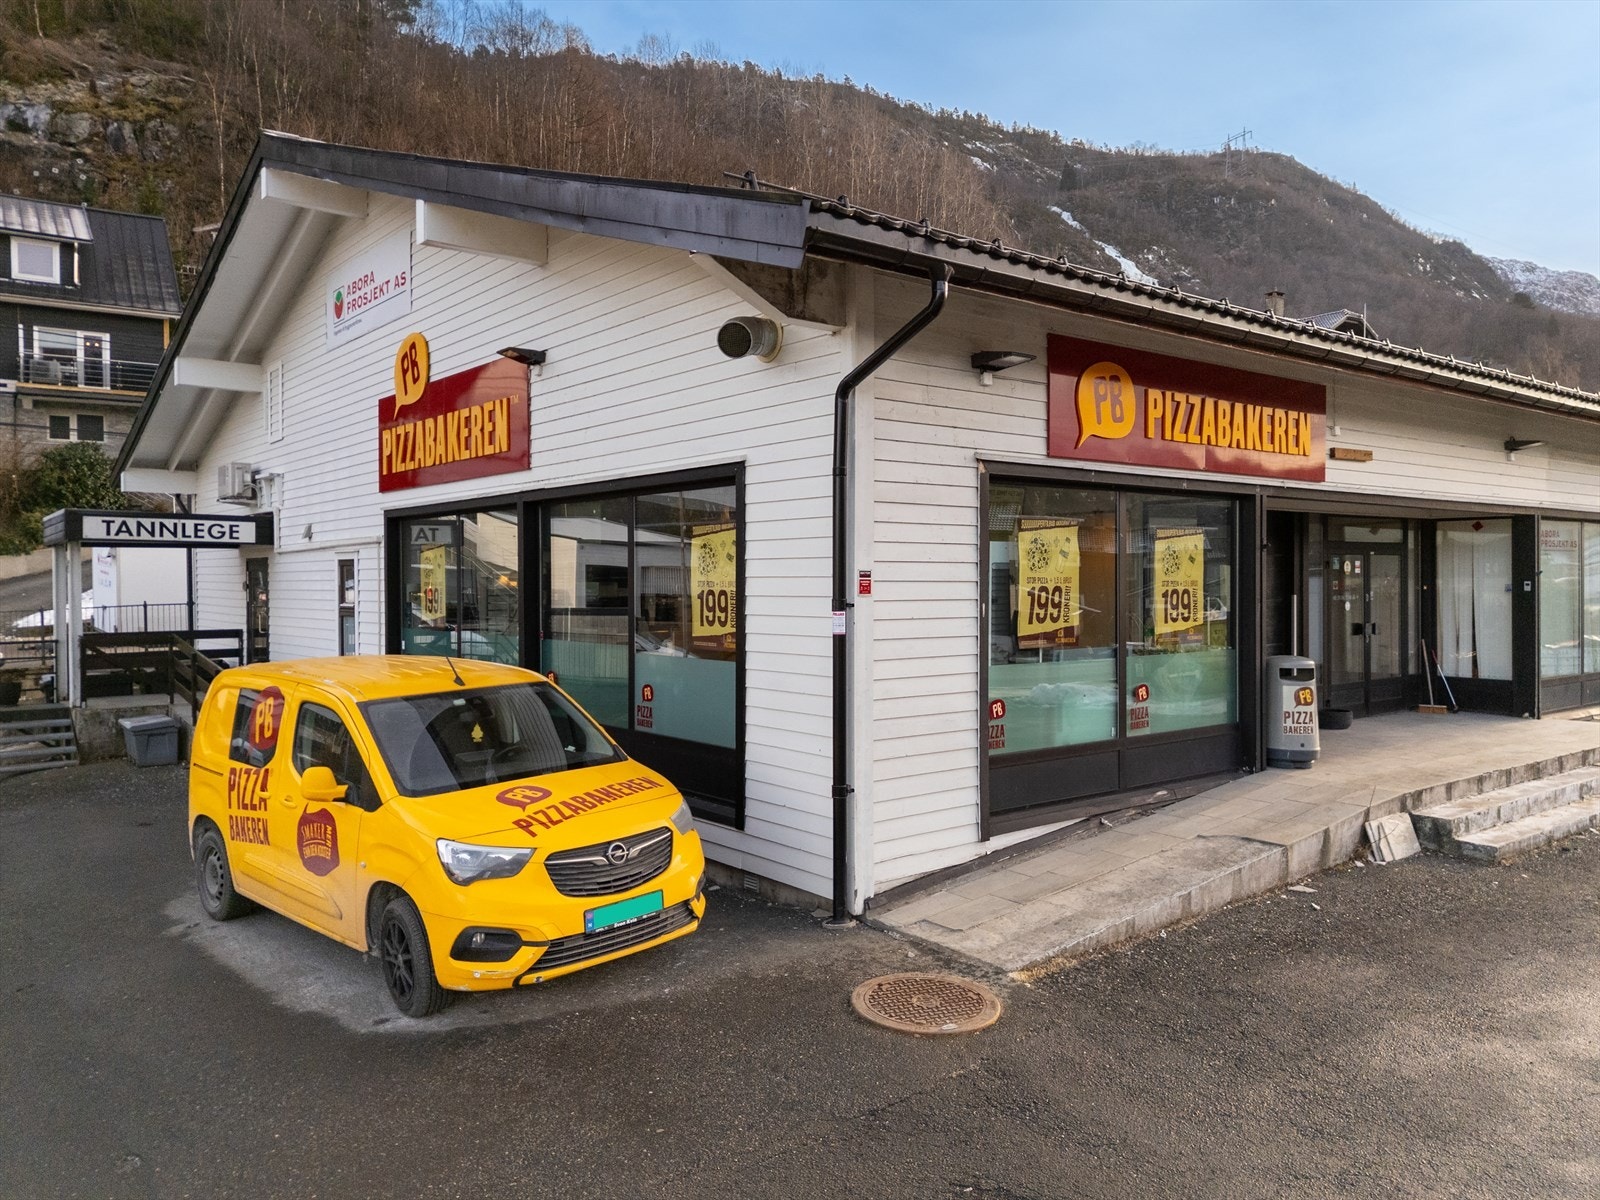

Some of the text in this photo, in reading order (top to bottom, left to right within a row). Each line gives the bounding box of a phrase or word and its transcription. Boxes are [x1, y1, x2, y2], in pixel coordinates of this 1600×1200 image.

[346, 271, 375, 298] ABORA
[346, 271, 407, 315] PROSJEKT AS
[400, 341, 419, 396] PB
[1093, 374, 1125, 426] PB
[382, 397, 510, 476] PIZZABAKEREN
[1144, 387, 1312, 457] PIZZABAKEREN
[101, 519, 240, 540] TANNLEGE
[697, 589, 729, 628] 199
[1027, 585, 1063, 625] 199
[1161, 588, 1191, 624] 199
[636, 704, 653, 719] PIZZA
[992, 702, 1003, 718] PB
[1130, 706, 1149, 720] PIZZA
[1299, 689, 1312, 704] PB
[255, 696, 274, 744] PB
[1283, 711, 1314, 724] PIZZA
[1283, 725, 1314, 735] BAKEREN
[228, 767, 270, 812] PIZZA
[504, 788, 544, 803] PB
[512, 776, 664, 838] PIZZABAKEREN
[228, 814, 271, 846] BAKEREN
